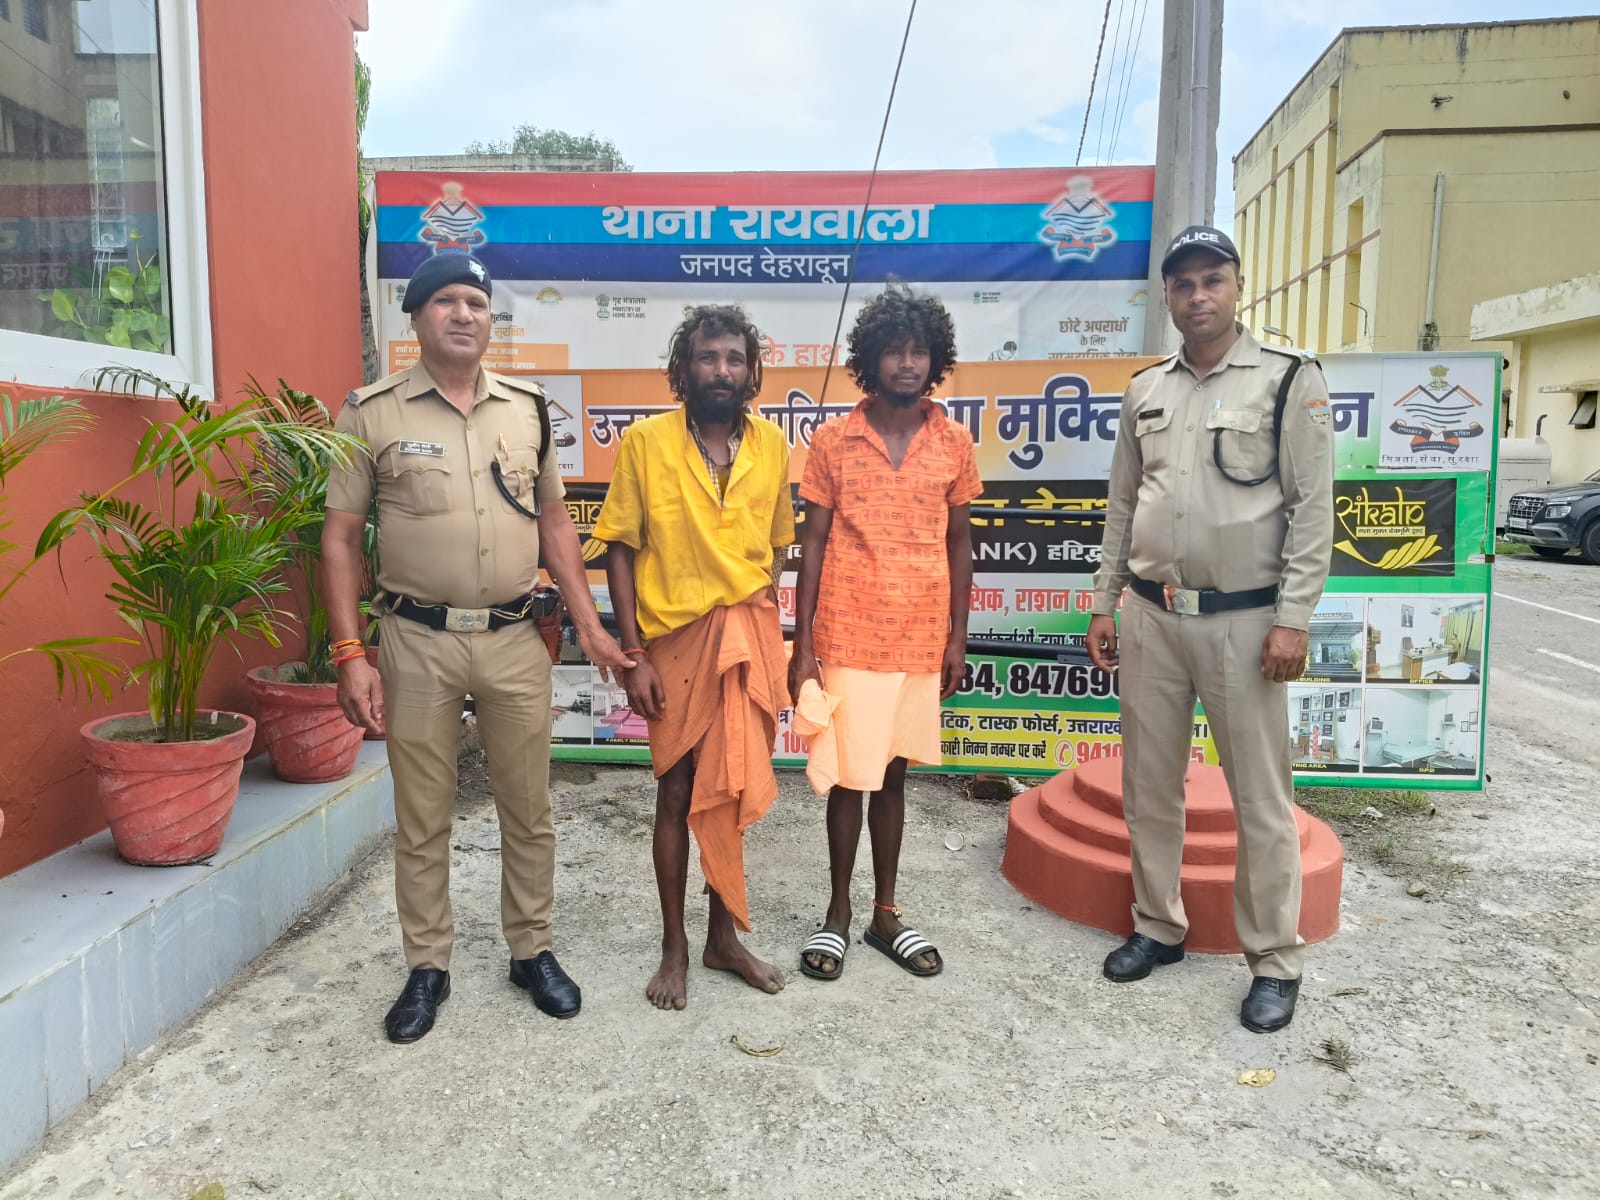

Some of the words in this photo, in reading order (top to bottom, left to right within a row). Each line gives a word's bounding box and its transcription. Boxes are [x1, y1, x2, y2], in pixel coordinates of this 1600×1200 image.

[602, 205, 717, 240] थाना
[728, 203, 935, 241] रायवाला
[1171, 231, 1220, 251] POLICE
[680, 253, 754, 277] जनपद
[760, 247, 850, 284] देहरादून
[1059, 317, 1082, 333] छोटे
[1084, 316, 1130, 333] अपराधों
[760, 335, 787, 365] के
[1090, 335, 1106, 346] लिए
[1015, 588, 1070, 613] राशन
[977, 715, 1019, 731] टास्क
[1021, 713, 1062, 735] फोर्स,
[990, 743, 1016, 757] नम्बर
[1018, 743, 1030, 758] पर
